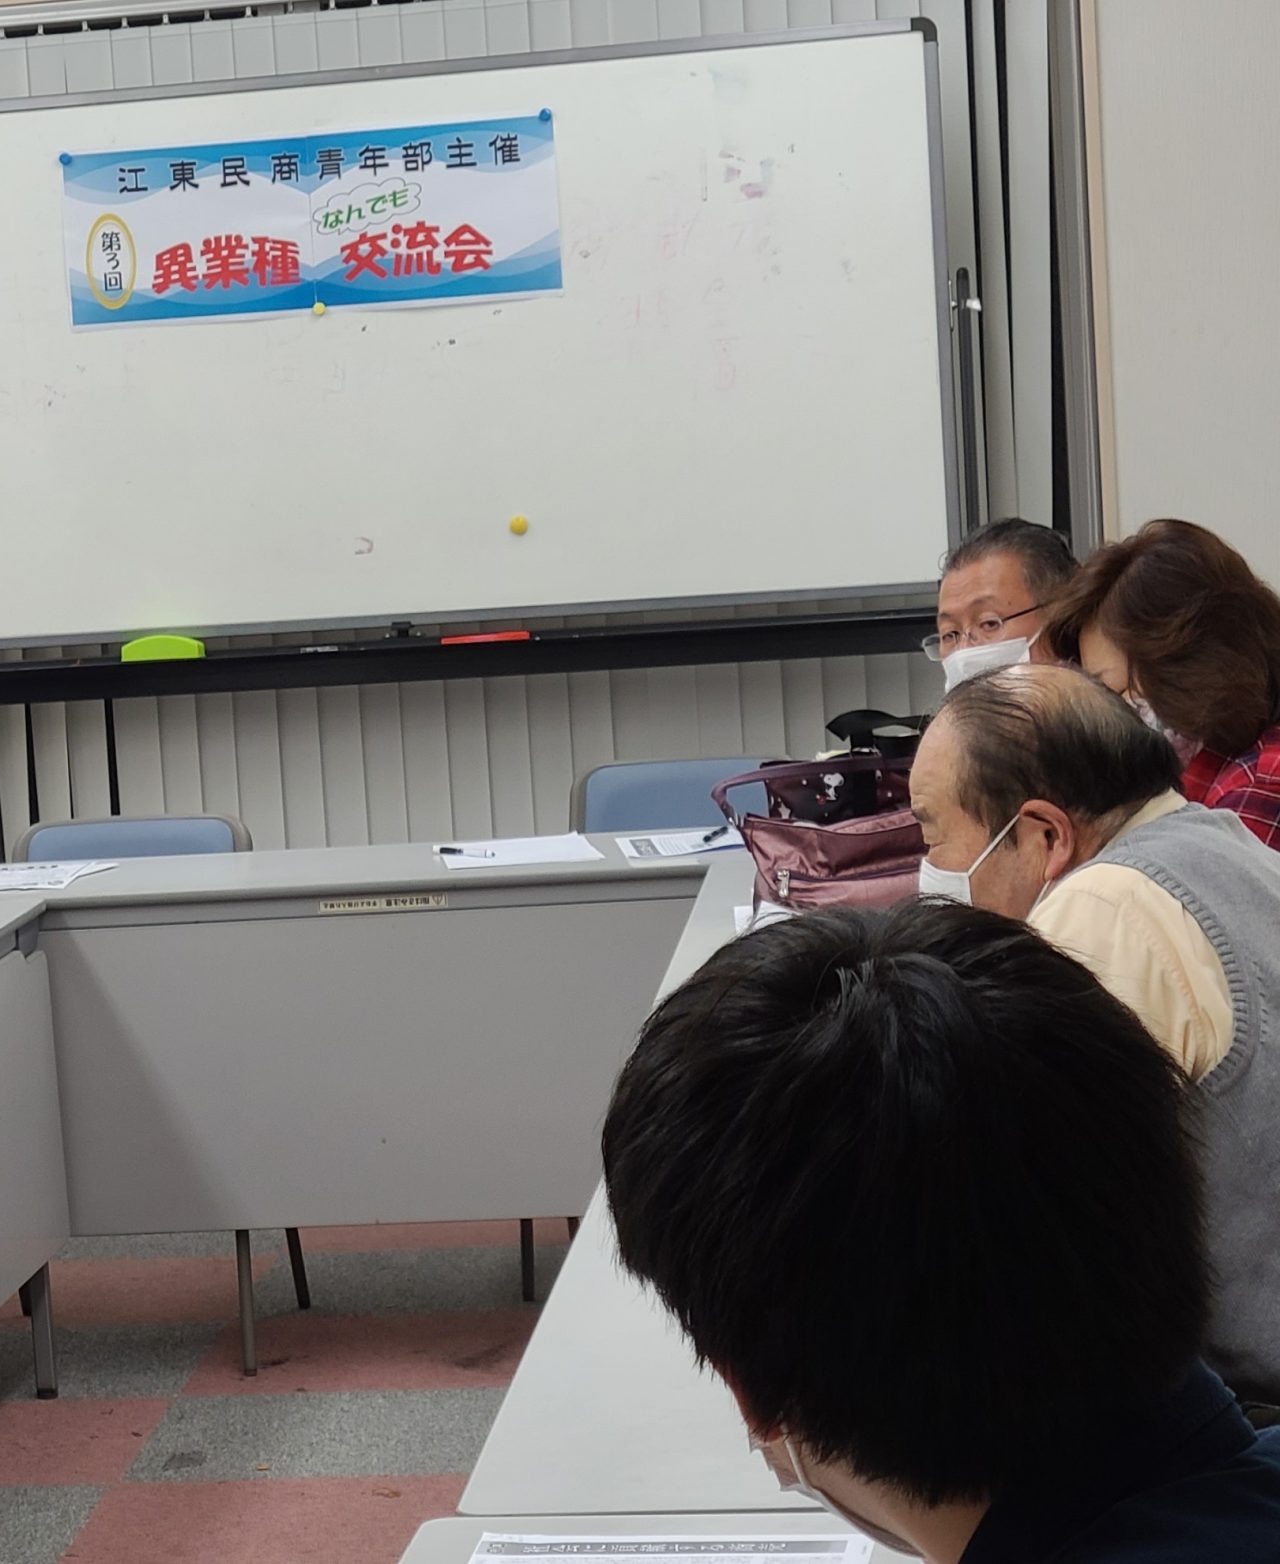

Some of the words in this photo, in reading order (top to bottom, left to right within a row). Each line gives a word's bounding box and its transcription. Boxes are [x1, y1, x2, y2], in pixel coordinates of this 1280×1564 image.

[118, 133, 521, 193] 江東民商青年部主催
[321, 188, 410, 230] なんでも
[152, 234, 302, 294] 異業種
[341, 221, 494, 282] 交流会
